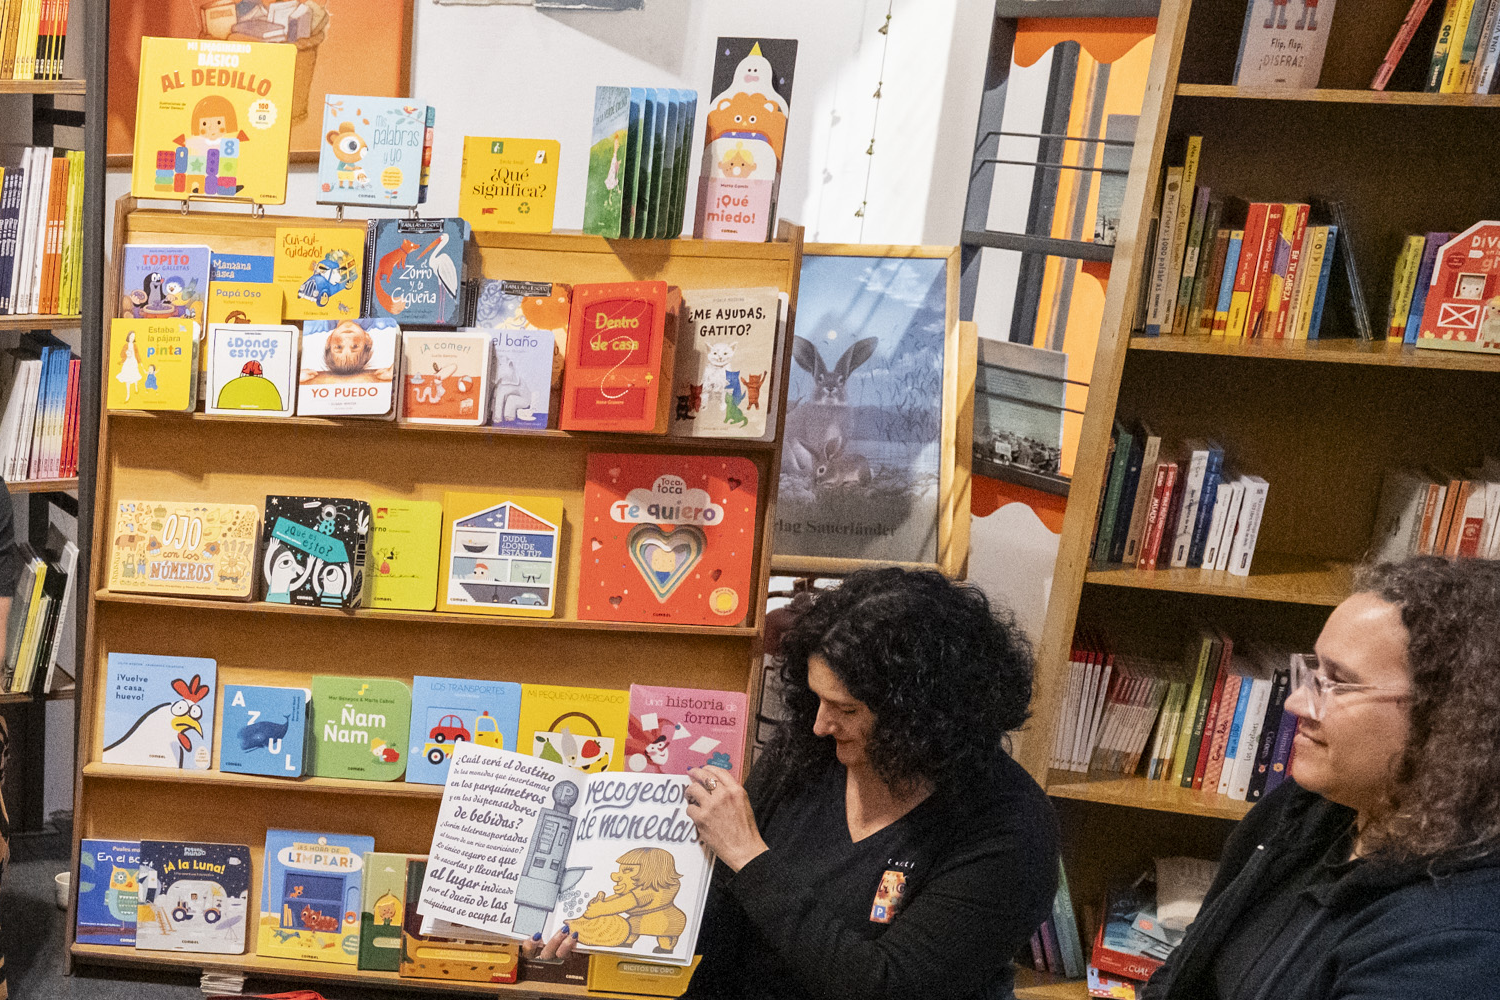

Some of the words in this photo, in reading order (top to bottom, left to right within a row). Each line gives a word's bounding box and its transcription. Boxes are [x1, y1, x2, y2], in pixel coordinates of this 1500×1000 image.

[200, 42, 251, 53] IMAGINARIO
[198, 52, 239, 68] BÁSICO
[161, 70, 184, 93] AL
[192, 69, 272, 97] DEDILLO
[373, 124, 420, 149] palabras
[224, 141, 235, 156] 8
[390, 148, 402, 165] yo
[490, 167, 528, 183] ¿Qué
[472, 183, 547, 200] significa?
[717, 195, 749, 209] ¡Qué
[707, 210, 756, 224] miedo!
[142, 254, 190, 266] TOPITO
[285, 246, 323, 258] cuidado!
[213, 259, 252, 270] Manzana
[400, 264, 433, 280] Zorro
[216, 288, 240, 298] Papá
[243, 290, 262, 298] Oso
[1282, 272, 1295, 301] CABEZA
[391, 288, 437, 309] Cigüeña
[595, 313, 639, 330] Dentro
[688, 307, 711, 324] ¿ME
[715, 306, 766, 322] AYUDAS,
[148, 326, 175, 334] Estaba
[700, 324, 752, 338] GATITO?
[156, 334, 181, 344] pájara
[492, 334, 502, 346] el
[506, 334, 538, 348] baño
[592, 337, 609, 352] de
[612, 339, 640, 352] casa
[147, 344, 182, 358] pinta
[229, 348, 276, 362] estoy?
[434, 342, 471, 354] comer!
[311, 388, 330, 398] YO
[334, 386, 378, 398] PUEDO
[658, 484, 683, 495] toca
[616, 504, 640, 520] Te
[647, 500, 716, 522] quiero
[162, 514, 203, 551] OJO
[806, 519, 898, 538] Sauerländer
[163, 551, 180, 559] con
[183, 550, 200, 560] los
[150, 561, 215, 583] NÚMEROS
[116, 674, 148, 683] ¡Vuelve
[116, 692, 144, 701] huevo!
[124, 685, 145, 693] casa,
[430, 682, 446, 692] LOS
[449, 682, 506, 696] TRANSPORTES
[580, 692, 624, 704] MERCADO
[666, 695, 724, 712] historia
[340, 704, 386, 729] Ñam
[684, 712, 737, 728] formas
[323, 719, 369, 744] Ñam
[455, 754, 480, 766] ¿Cuál
[481, 756, 502, 767] será
[514, 761, 556, 783] destino
[507, 774, 551, 792] insertamos
[473, 783, 546, 805] parquímetros
[472, 795, 538, 818] dispensadores
[470, 808, 524, 830] bebidas?
[576, 810, 597, 841] de
[600, 808, 700, 844] monedas
[461, 823, 529, 844] teletransportadas
[96, 852, 115, 862] En
[116, 853, 126, 863] el
[288, 852, 354, 868] LIMPIAR!
[163, 861, 176, 874] ¡A
[178, 860, 190, 872] la
[193, 860, 226, 875] Luna!
[468, 865, 474, 874] y
[474, 865, 520, 882] llevarlas
[446, 869, 480, 890] lugar
[480, 881, 514, 894] indicado
[423, 898, 456, 914] máquinas
[449, 890, 476, 905] dueño
[490, 898, 508, 911] las
[623, 964, 647, 974] RICITOS
[650, 966, 658, 974] DE
[660, 967, 675, 975] ORO
